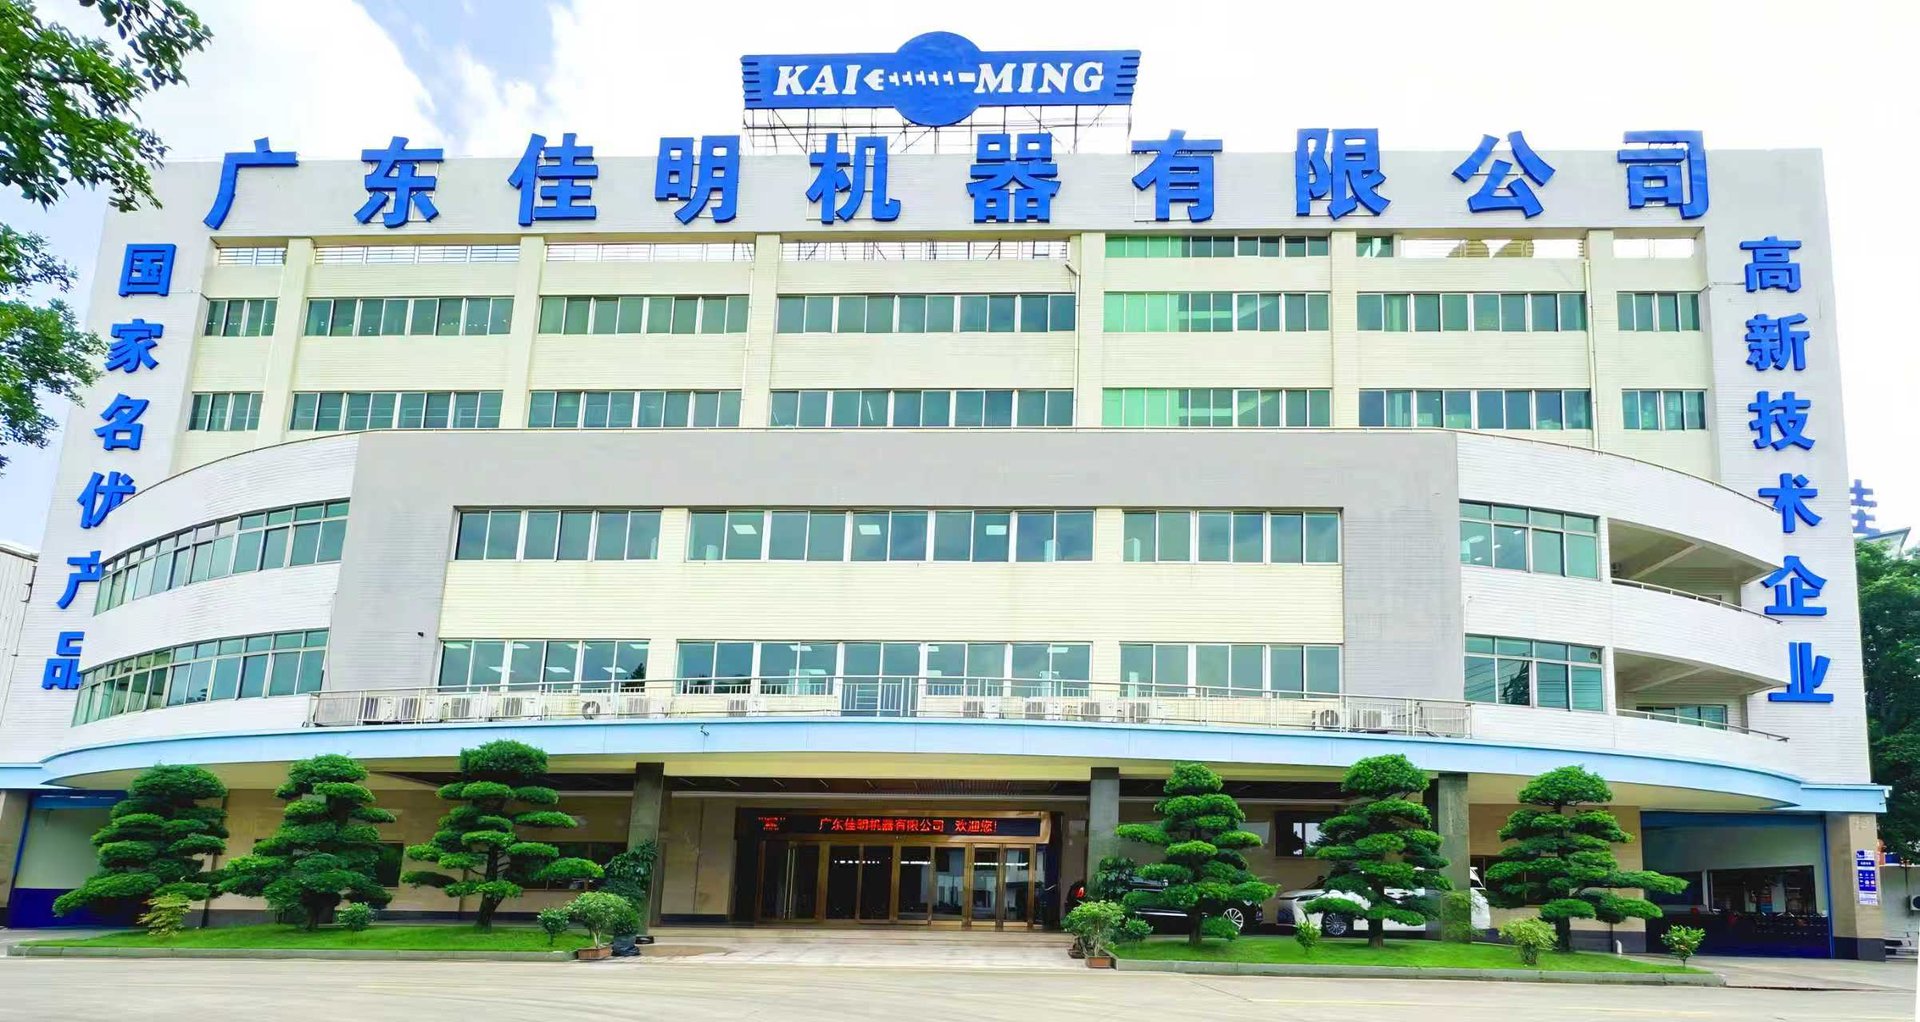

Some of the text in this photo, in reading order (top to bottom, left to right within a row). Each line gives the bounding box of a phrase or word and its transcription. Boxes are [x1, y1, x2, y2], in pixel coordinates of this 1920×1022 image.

[773, 61, 1106, 96] KAI MING
[204, 128, 1710, 229] 广东佳明机器有限公司
[42, 242, 177, 691] 国家名优产品
[1739, 234, 1834, 703] 高新技术企业
[818, 817, 945, 833] 广东佳明机器有限公司
